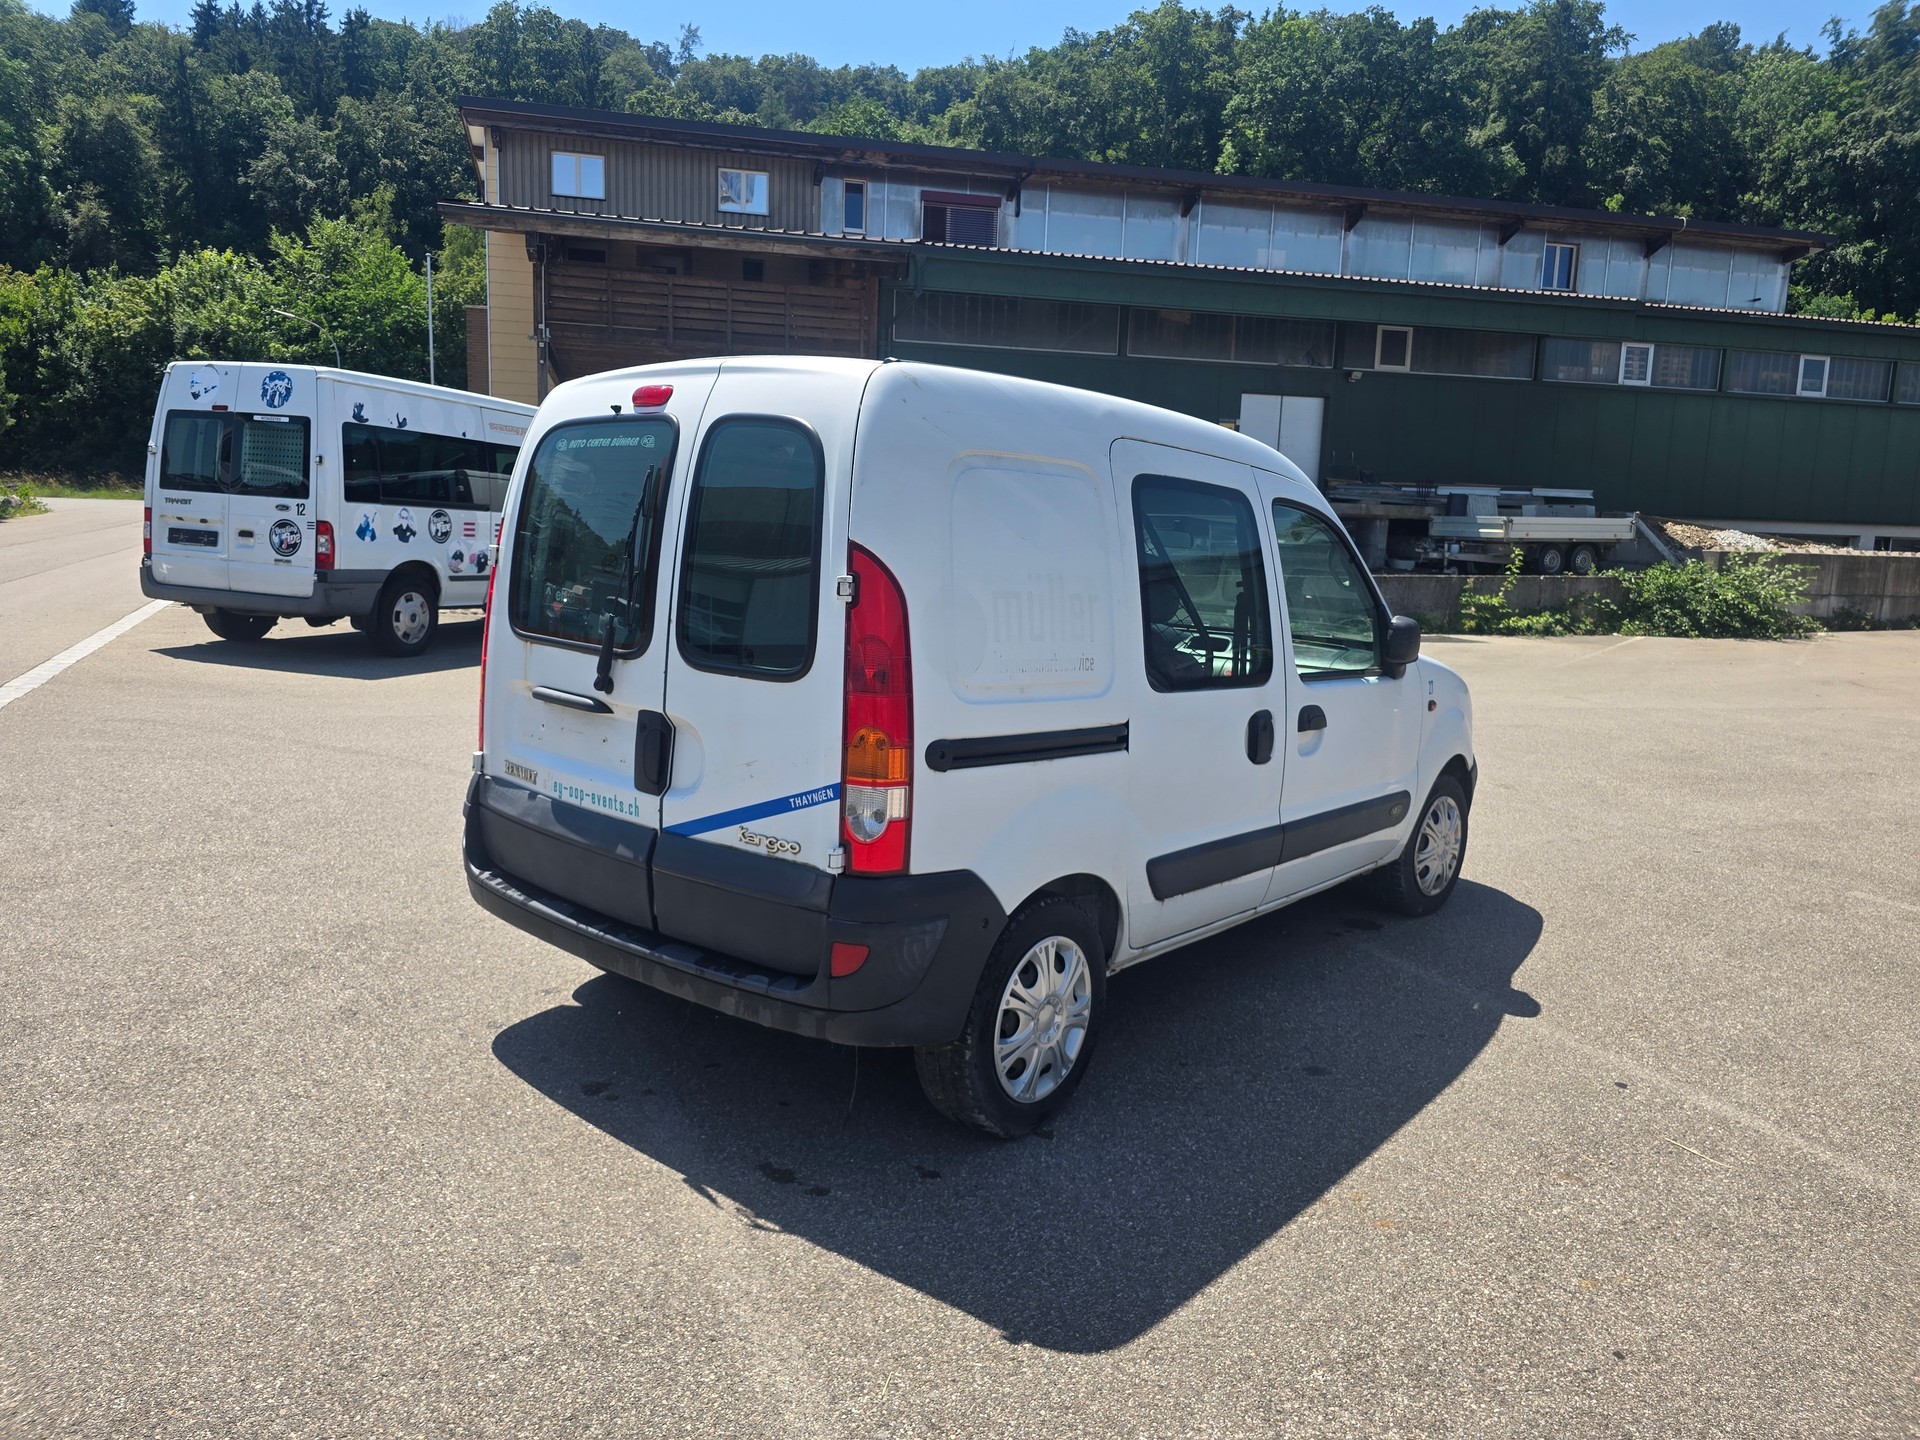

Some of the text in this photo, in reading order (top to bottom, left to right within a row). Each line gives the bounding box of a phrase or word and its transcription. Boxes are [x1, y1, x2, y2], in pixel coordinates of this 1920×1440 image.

[568, 439, 587, 449] AUTO
[587, 438, 609, 448] CENTER
[164, 497, 193, 505] TRANSIT
[295, 502, 307, 516] 12
[504, 760, 538, 786] RENAULT
[789, 788, 834, 809] THAYNGEN
[738, 825, 801, 855] Kangoo
